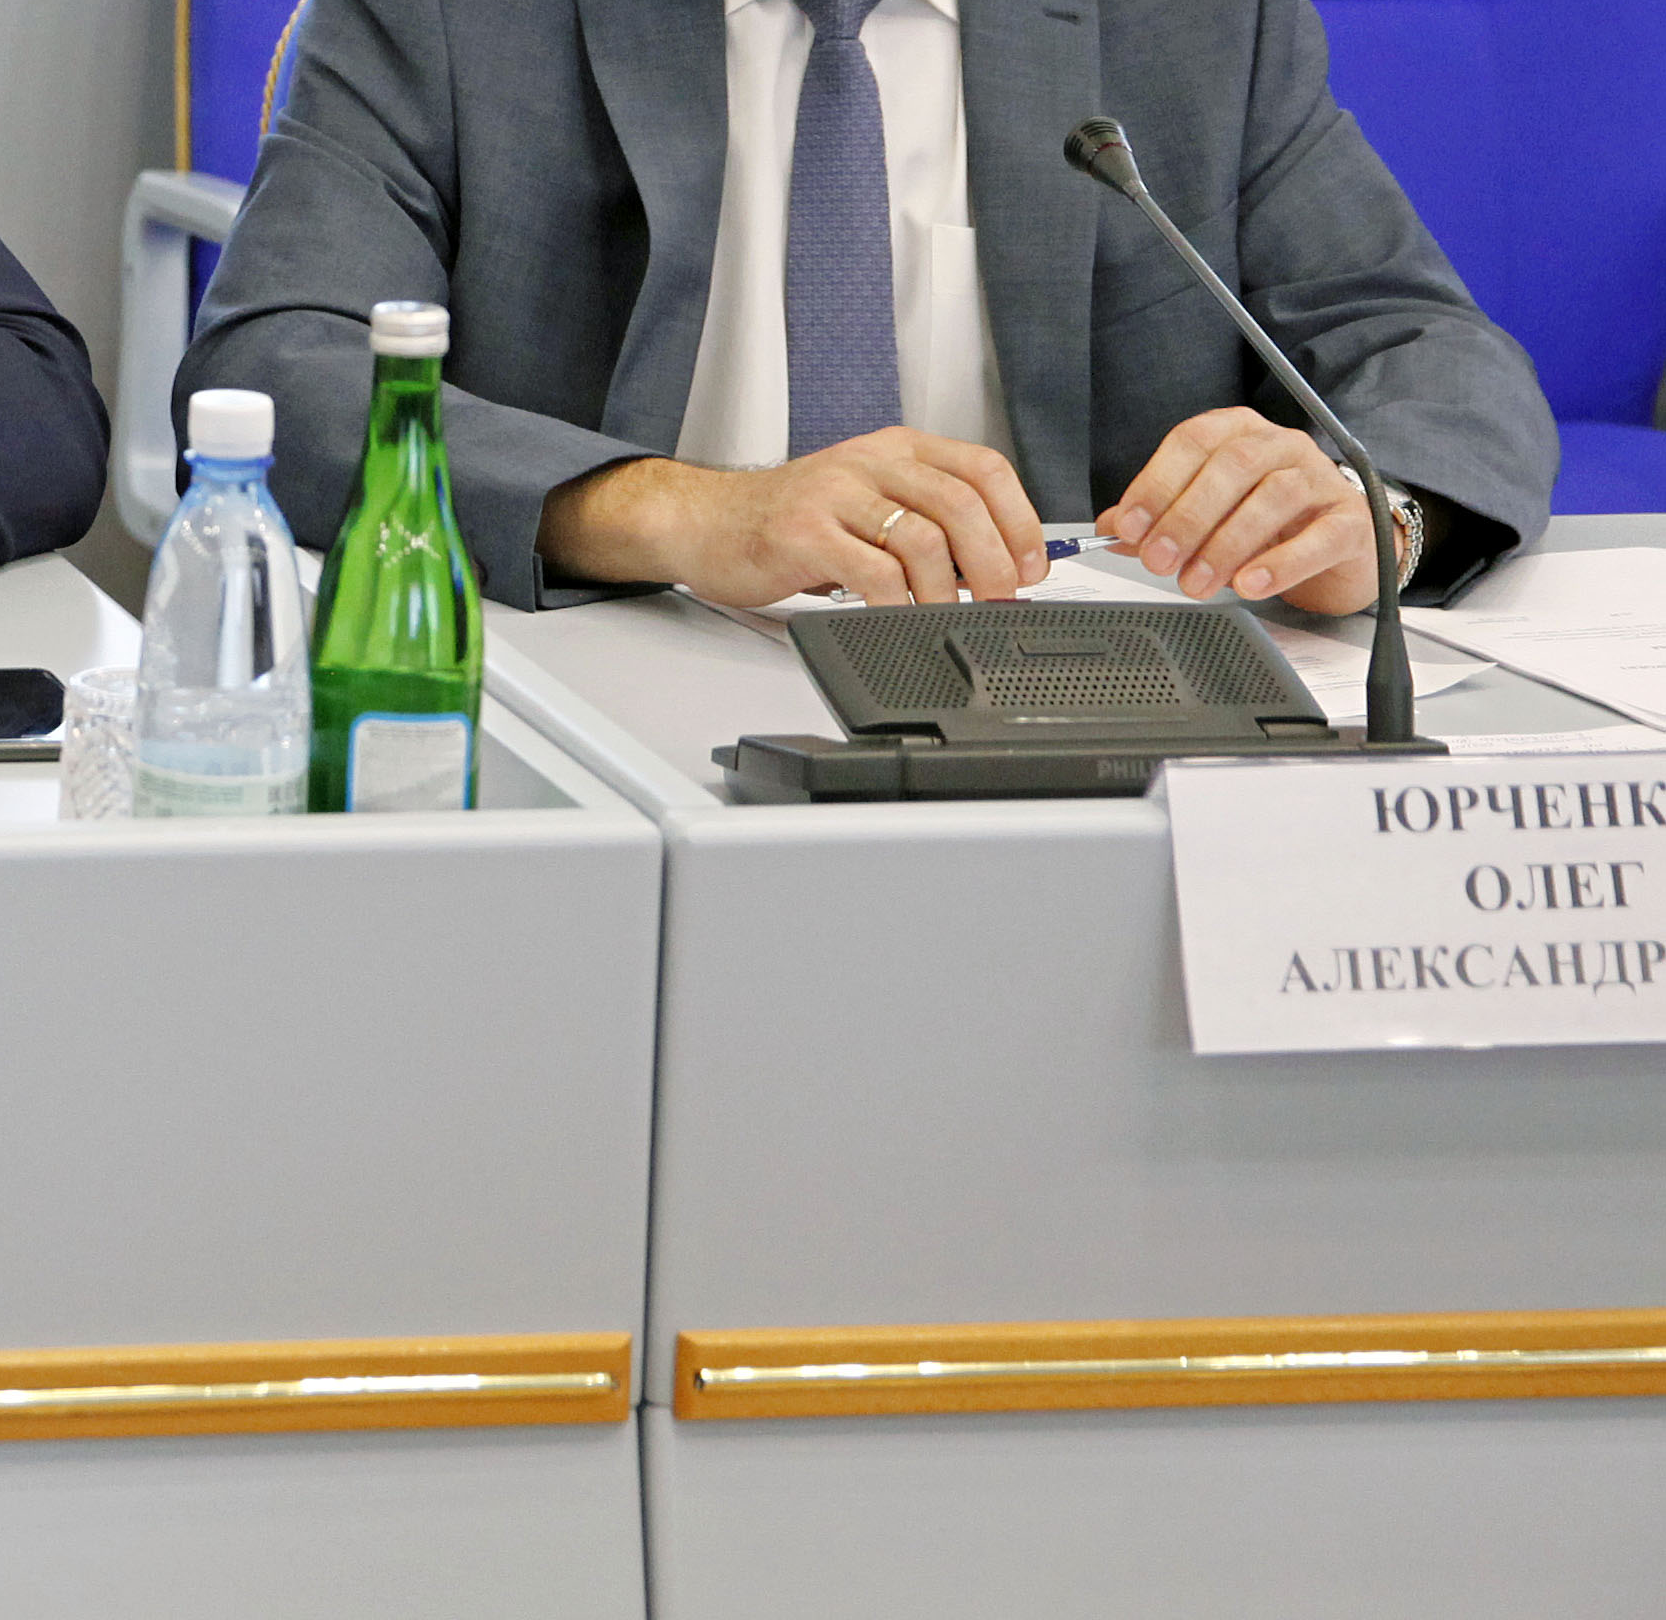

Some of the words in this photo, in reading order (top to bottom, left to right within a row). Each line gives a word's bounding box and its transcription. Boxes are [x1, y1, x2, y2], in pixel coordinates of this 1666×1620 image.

[1370, 781, 1666, 834] ЮРЧЕНК
[1464, 860, 1646, 912] ОЛЕГ
[1279, 938, 1666, 997] АЛЕКСАНДР
